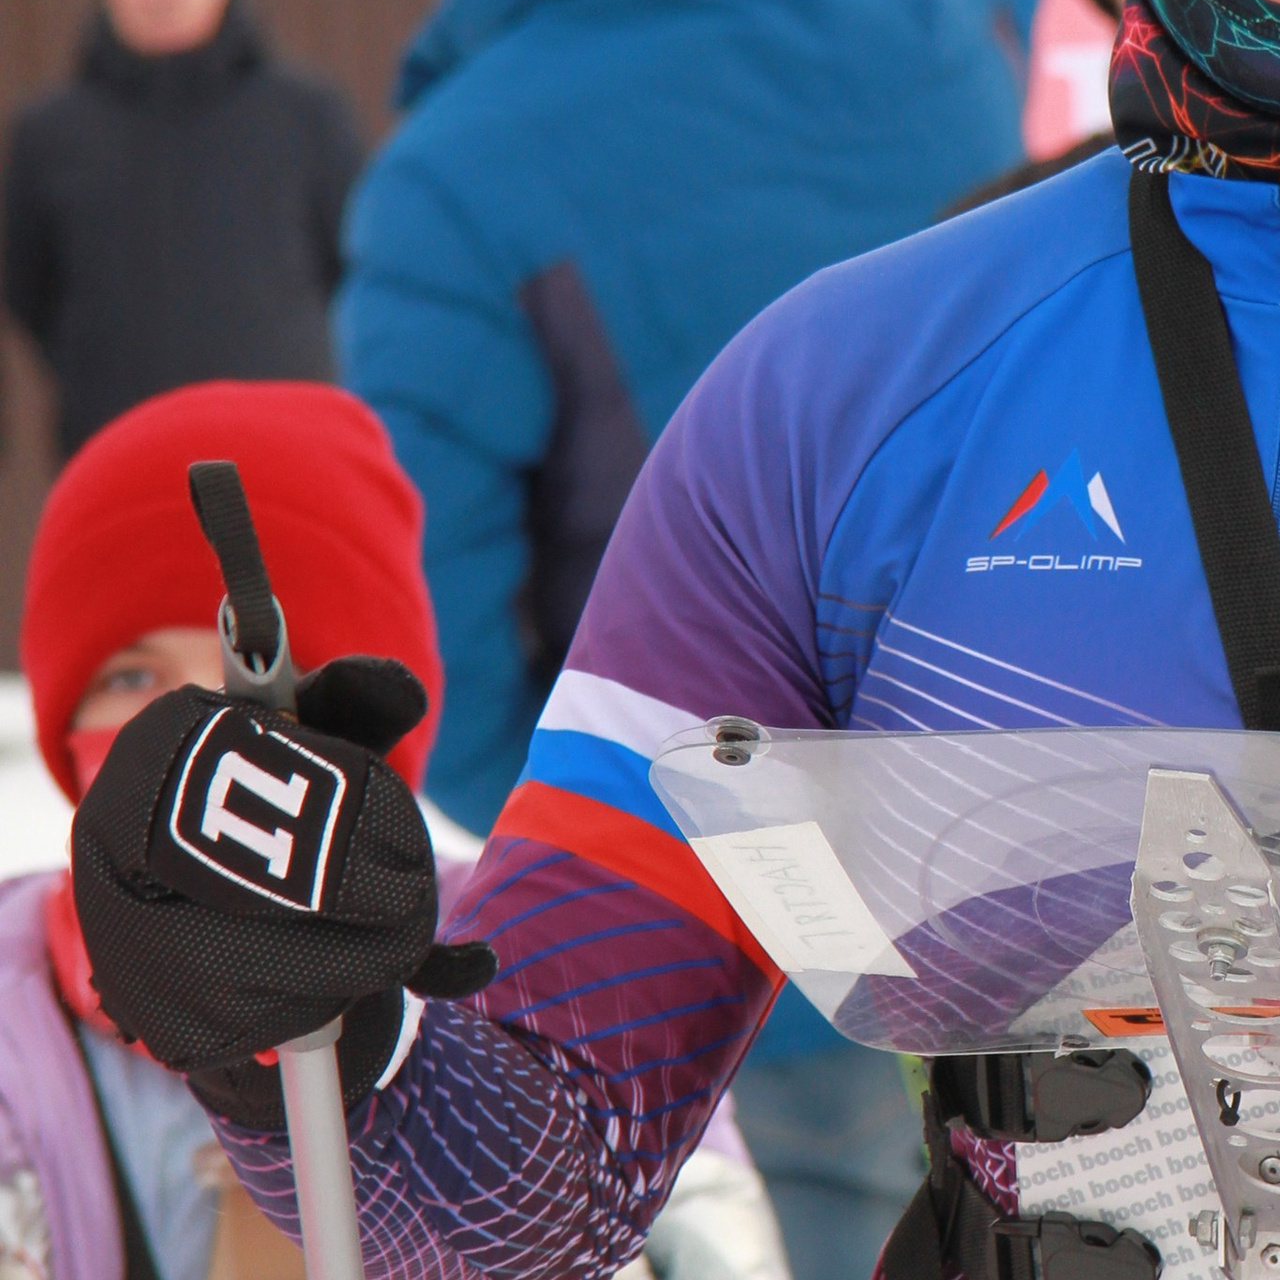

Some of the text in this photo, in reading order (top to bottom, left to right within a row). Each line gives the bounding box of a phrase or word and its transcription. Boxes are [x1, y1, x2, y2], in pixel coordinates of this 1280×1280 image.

[965, 555, 1143, 572] SP-OLIMP
[1019, 1160, 1076, 1190] ooch
[1077, 1135, 1153, 1171] booch
[1088, 1164, 1163, 1198] booch
[1098, 1191, 1174, 1224] booch
